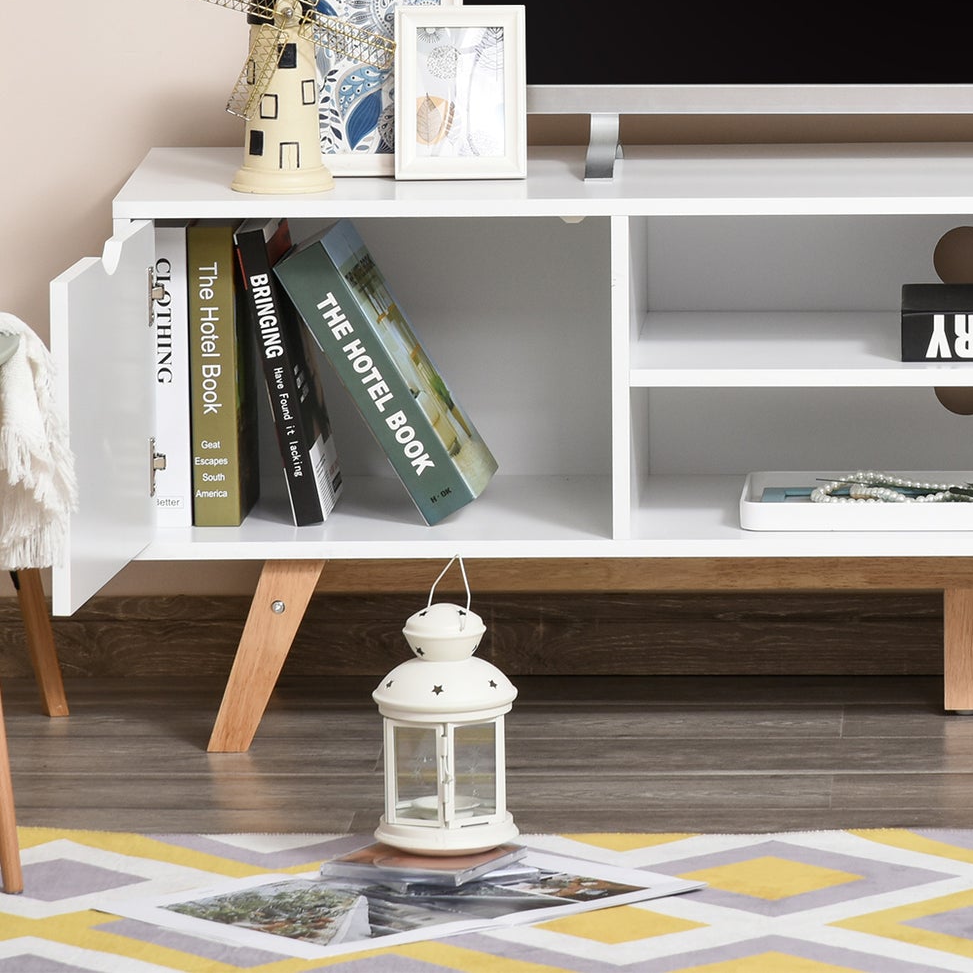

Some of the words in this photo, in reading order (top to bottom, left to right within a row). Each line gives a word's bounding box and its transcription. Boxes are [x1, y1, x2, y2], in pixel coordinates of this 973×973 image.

[199, 262, 218, 300] The
[200, 307, 220, 357] Hotel
[250, 273, 284, 359] BRINGING
[201, 364, 222, 415] Book
[273, 367, 284, 390] Have
[316, 291, 354, 341] THE
[342, 338, 394, 413] HOTEL
[385, 410, 435, 476] BOOK
[279, 392, 293, 421] Found
[285, 425, 296, 436] it
[194, 456, 229, 467] Escapes
[288, 440, 303, 478] lacking
[195, 489, 228, 498] America
[202, 473, 226, 482] South
